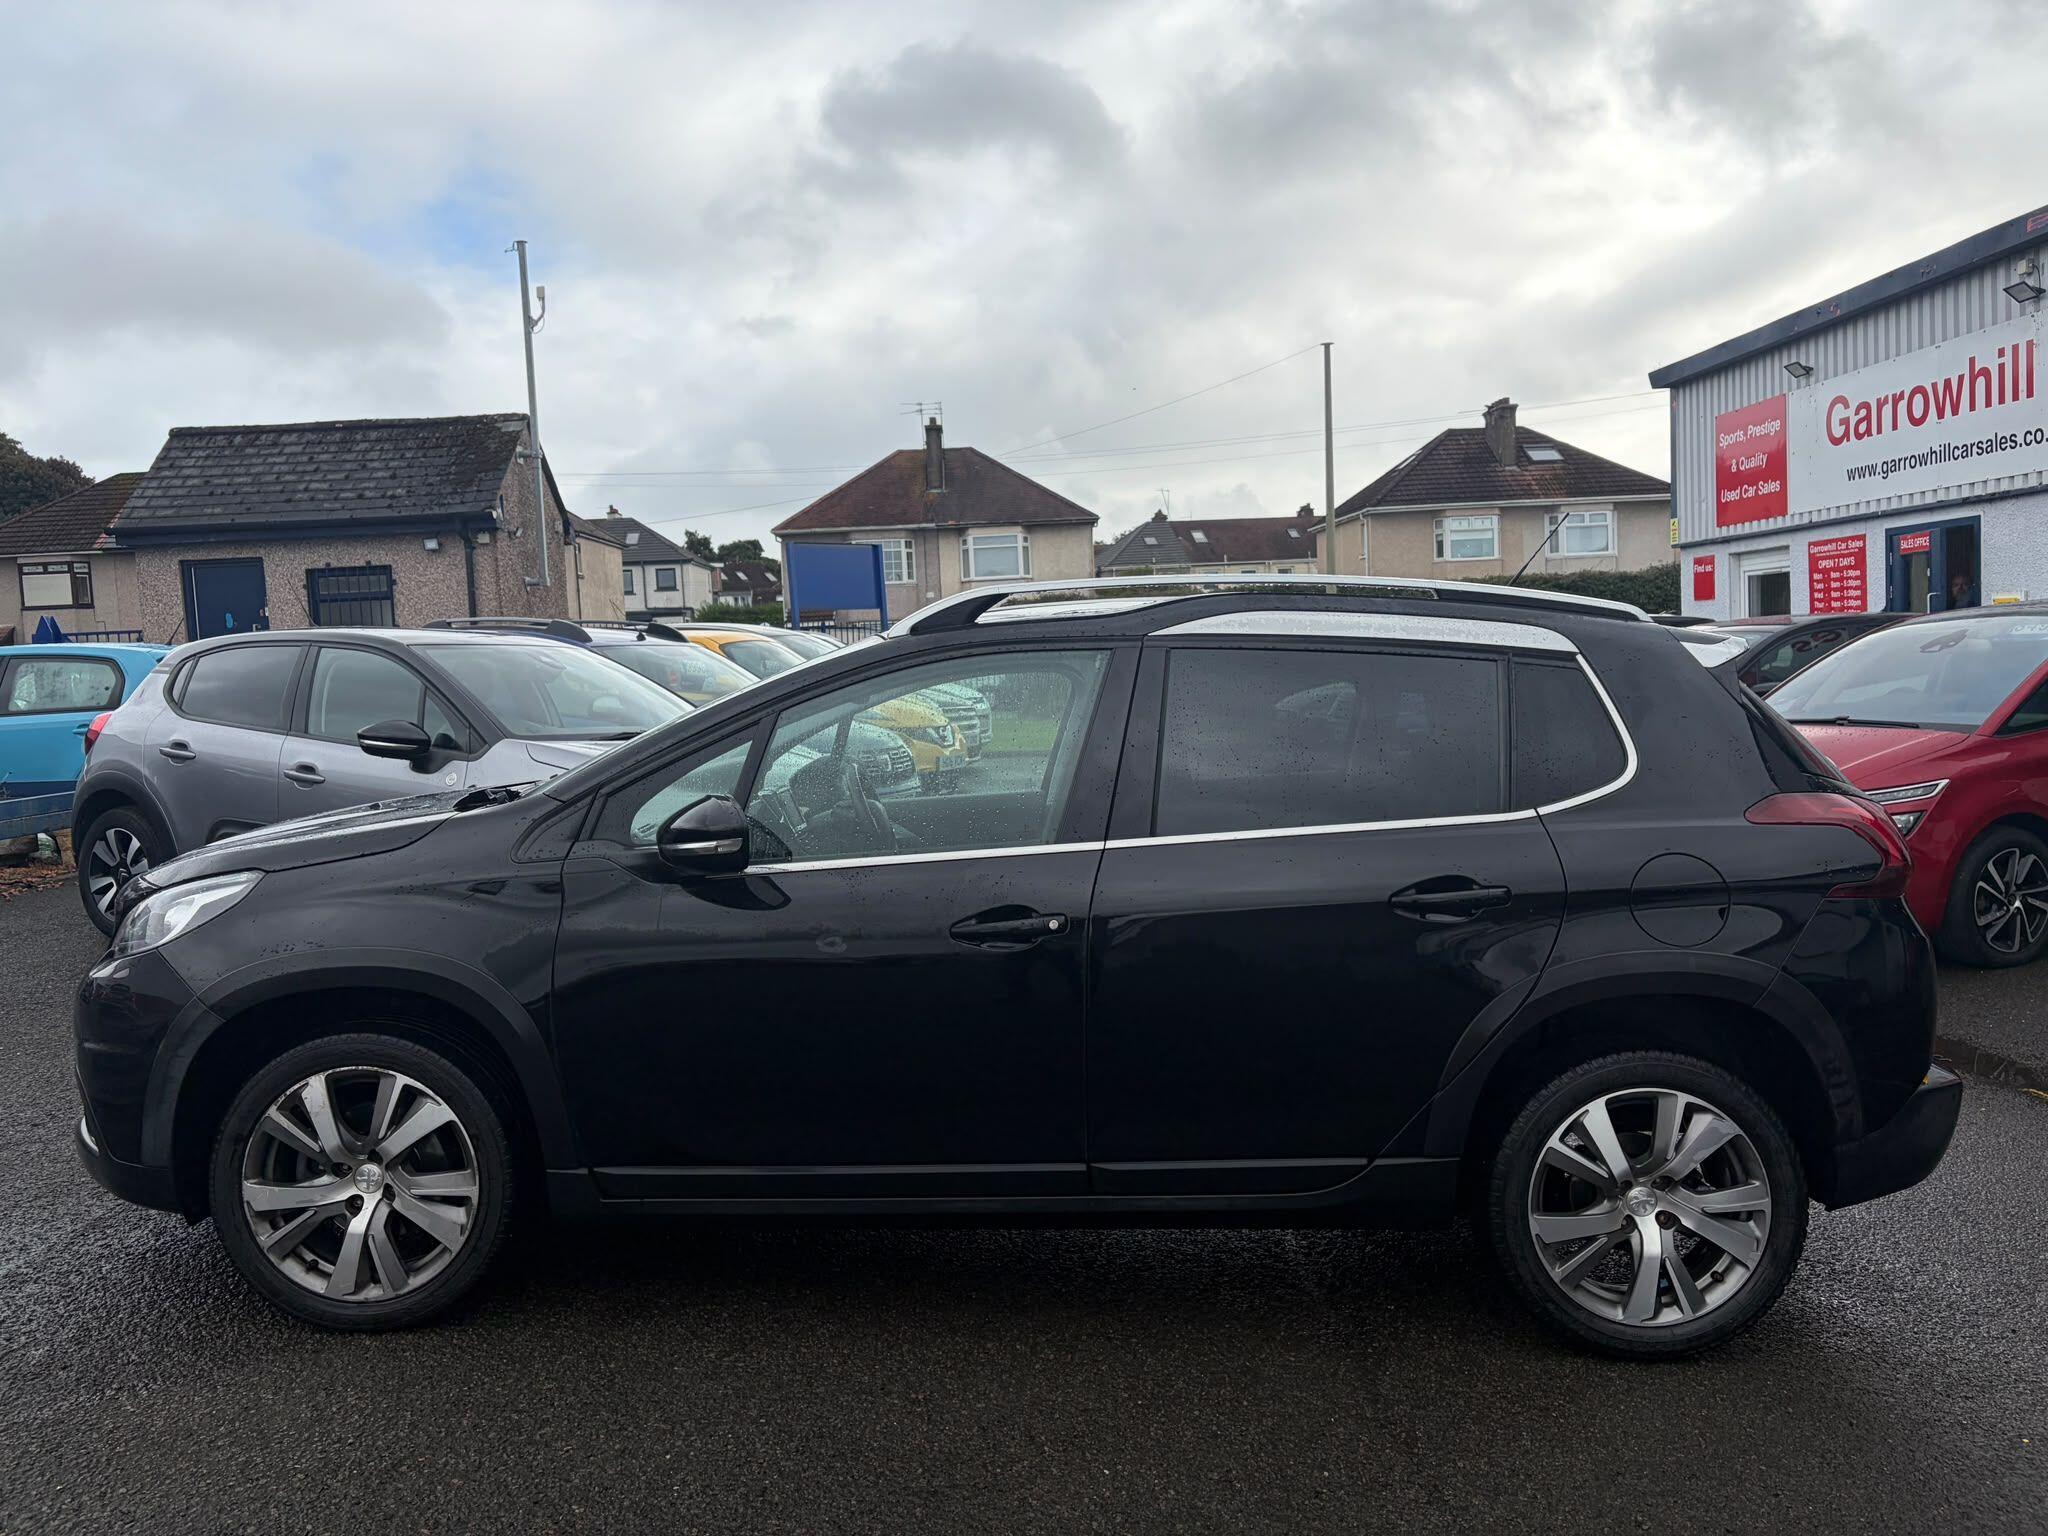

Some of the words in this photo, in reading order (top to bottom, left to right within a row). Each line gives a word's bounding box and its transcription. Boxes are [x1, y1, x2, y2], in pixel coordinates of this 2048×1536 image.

[1826, 338, 2034, 446] Garrowhill
[1719, 429, 1746, 448] Sports,
[1747, 418, 1781, 439] Prestige
[1731, 459, 1737, 472] &
[1739, 452, 1768, 471] Quality
[1721, 486, 1740, 503] Used
[1741, 484, 1756, 499] Car
[1758, 479, 1781, 496] Sales
[1809, 542, 1837, 554] Garrowhill
[1837, 541, 1847, 550] Car
[1848, 539, 1864, 549] Sales
[1900, 538, 1914, 549] SALES
[1914, 536, 1930, 547] OFFICE
[1694, 564, 1704, 573] Find
[1818, 558, 1834, 569] OPEN
[1839, 556, 1855, 567] DAYS
